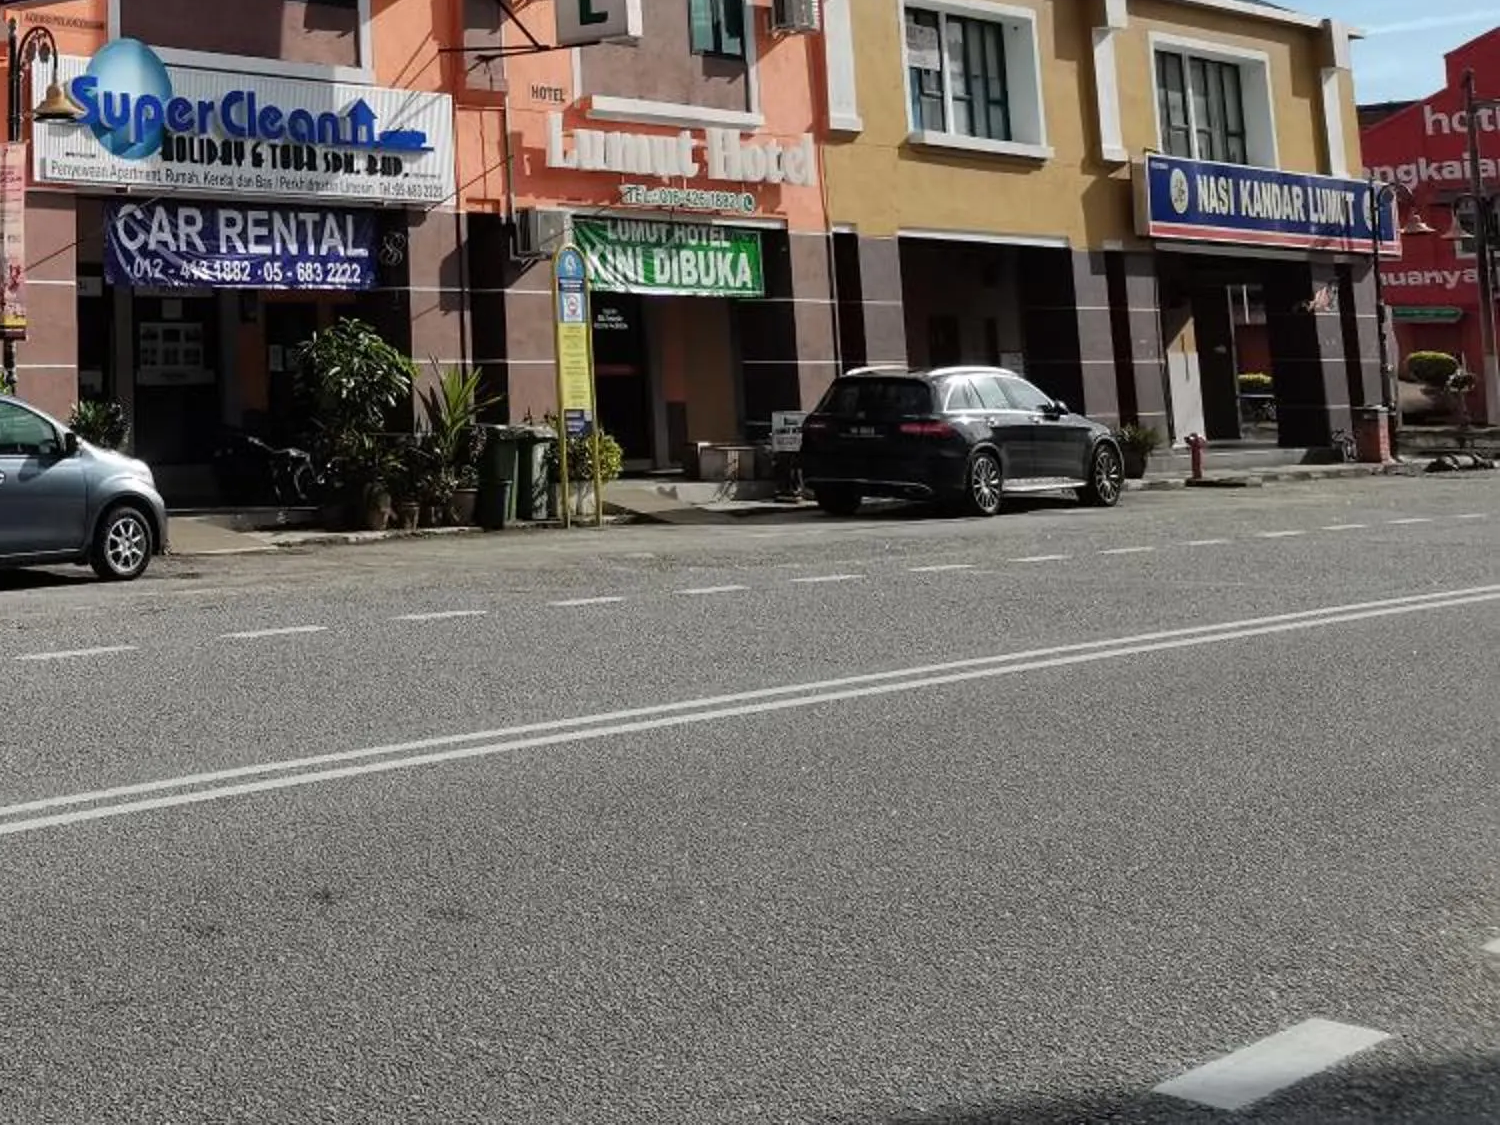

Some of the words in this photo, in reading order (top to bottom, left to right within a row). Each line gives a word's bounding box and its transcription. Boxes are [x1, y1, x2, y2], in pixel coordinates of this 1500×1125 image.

[531, 84, 566, 104] HOTEL
[160, 134, 245, 167] HOLIDAY
[268, 143, 318, 172] TOUR
[546, 110, 701, 179] Lumut
[704, 128, 817, 187] Hotel
[1196, 174, 1235, 216] NASI
[1239, 178, 1306, 222] KANDAR
[1307, 185, 1355, 227] LUMUT
[115, 203, 206, 252] CAR
[217, 208, 369, 257] RENTAL
[606, 219, 668, 244] LUMUT
[673, 223, 731, 248] HOTEL
[586, 243, 645, 284] KINI
[653, 248, 753, 288] DIBUKA
